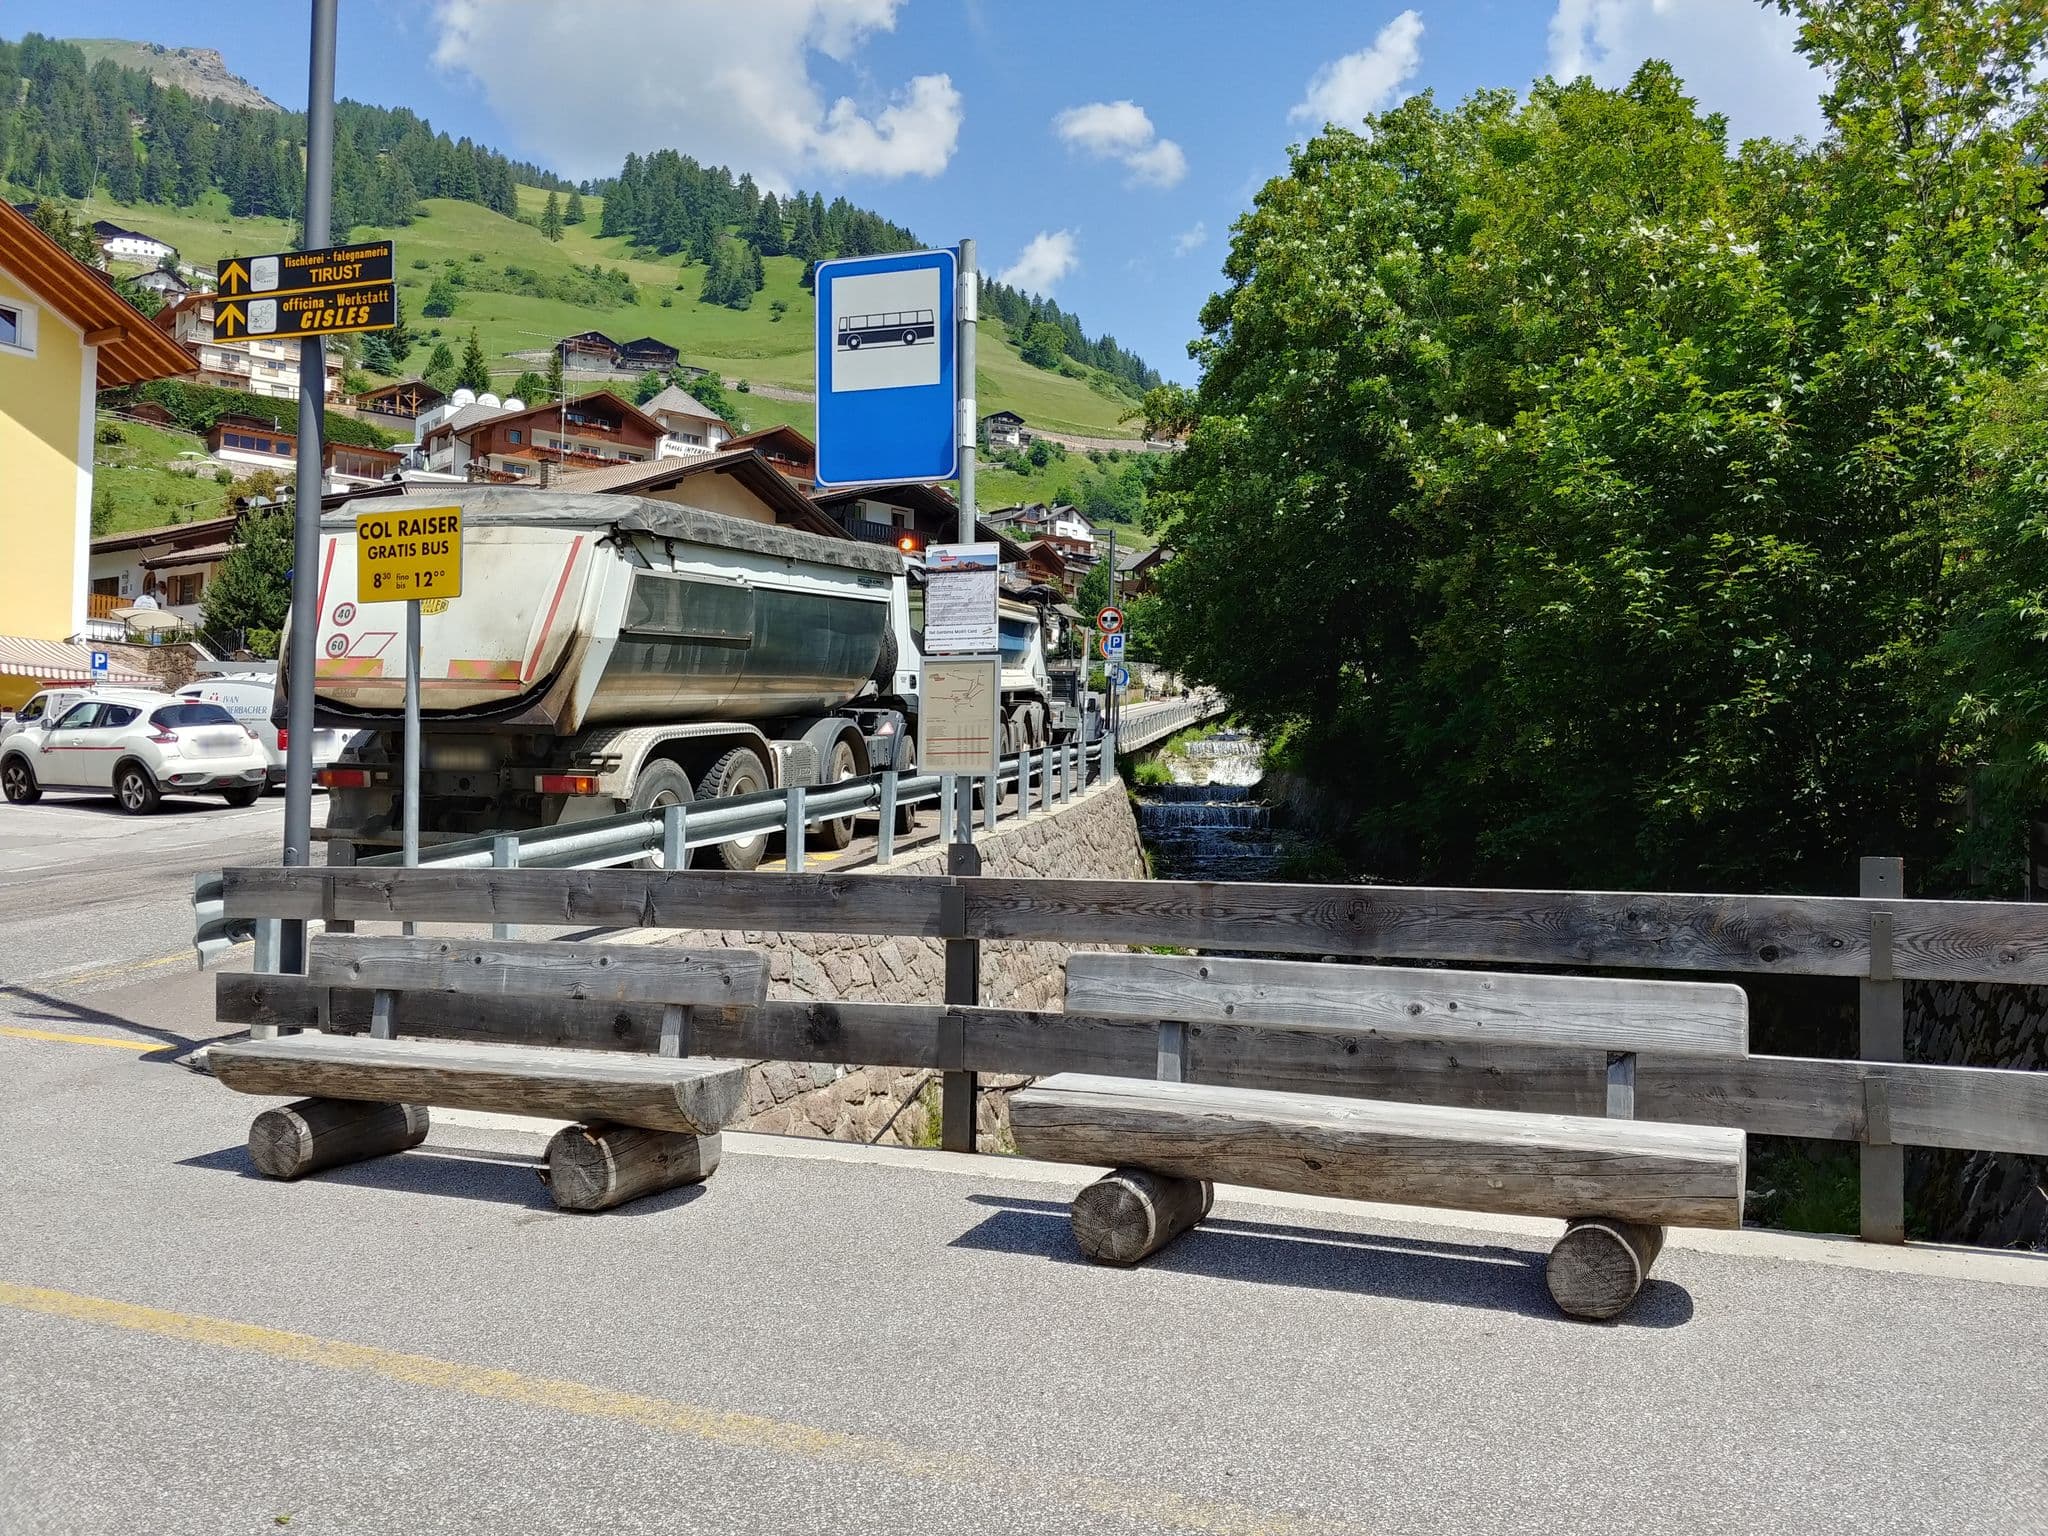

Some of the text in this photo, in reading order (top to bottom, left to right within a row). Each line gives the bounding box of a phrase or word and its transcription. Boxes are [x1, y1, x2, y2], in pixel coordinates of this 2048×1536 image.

[284, 253, 325, 268] Tischlerei
[333, 246, 389, 263] falegnameria
[309, 264, 362, 283] TIRUST
[282, 296, 325, 311] officina
[336, 289, 390, 307] Werkstatt
[359, 516, 458, 540] COL RAISER
[367, 540, 449, 560] GRATIS BUS
[396, 573, 410, 581] fino
[396, 582, 406, 590] bis
[337, 609, 351, 619] 40
[331, 640, 344, 651] 60
[1113, 637, 1121, 647] P
[94, 653, 106, 668] P
[222, 695, 240, 704] IVAN
